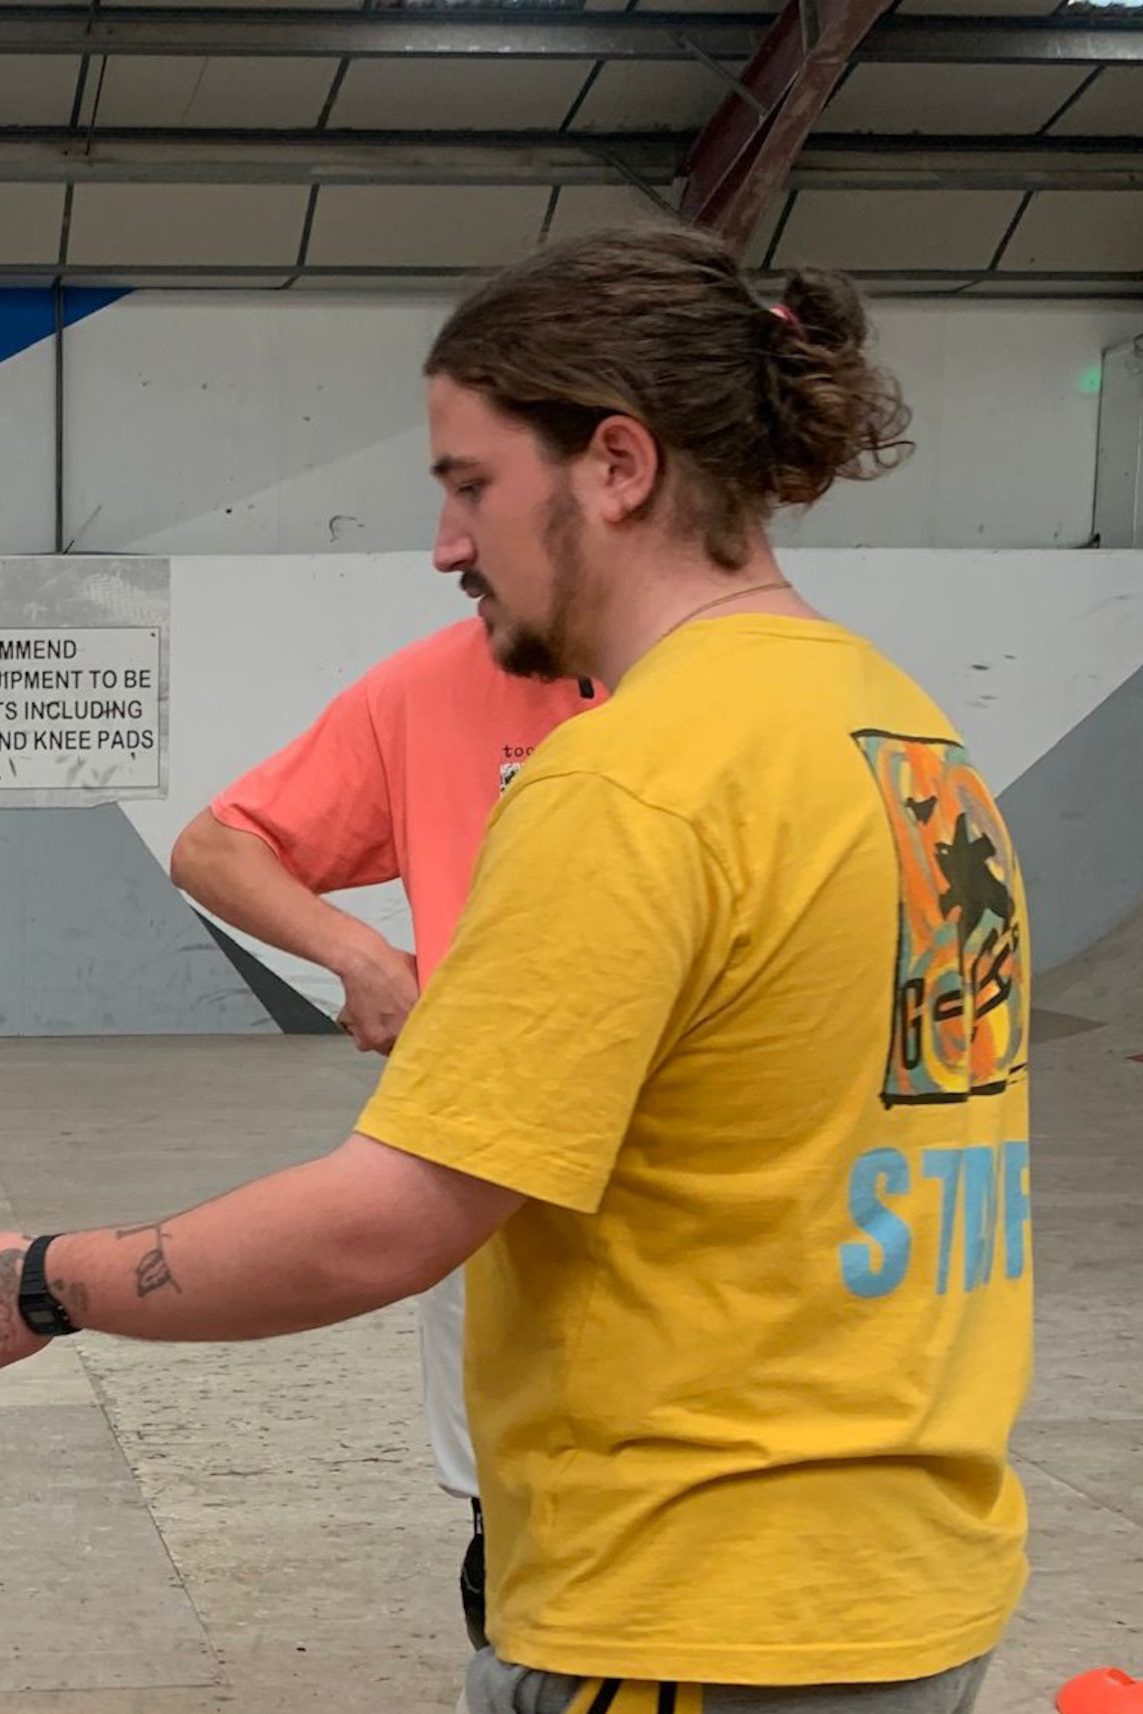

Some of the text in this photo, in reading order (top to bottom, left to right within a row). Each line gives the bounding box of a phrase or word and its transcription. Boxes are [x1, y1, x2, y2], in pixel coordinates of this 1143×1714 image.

[88, 670, 117, 689] TO
[124, 669, 151, 688] BE
[25, 700, 142, 720] INCLUDING
[34, 730, 91, 750] KNEE
[98, 729, 154, 749] PADS
